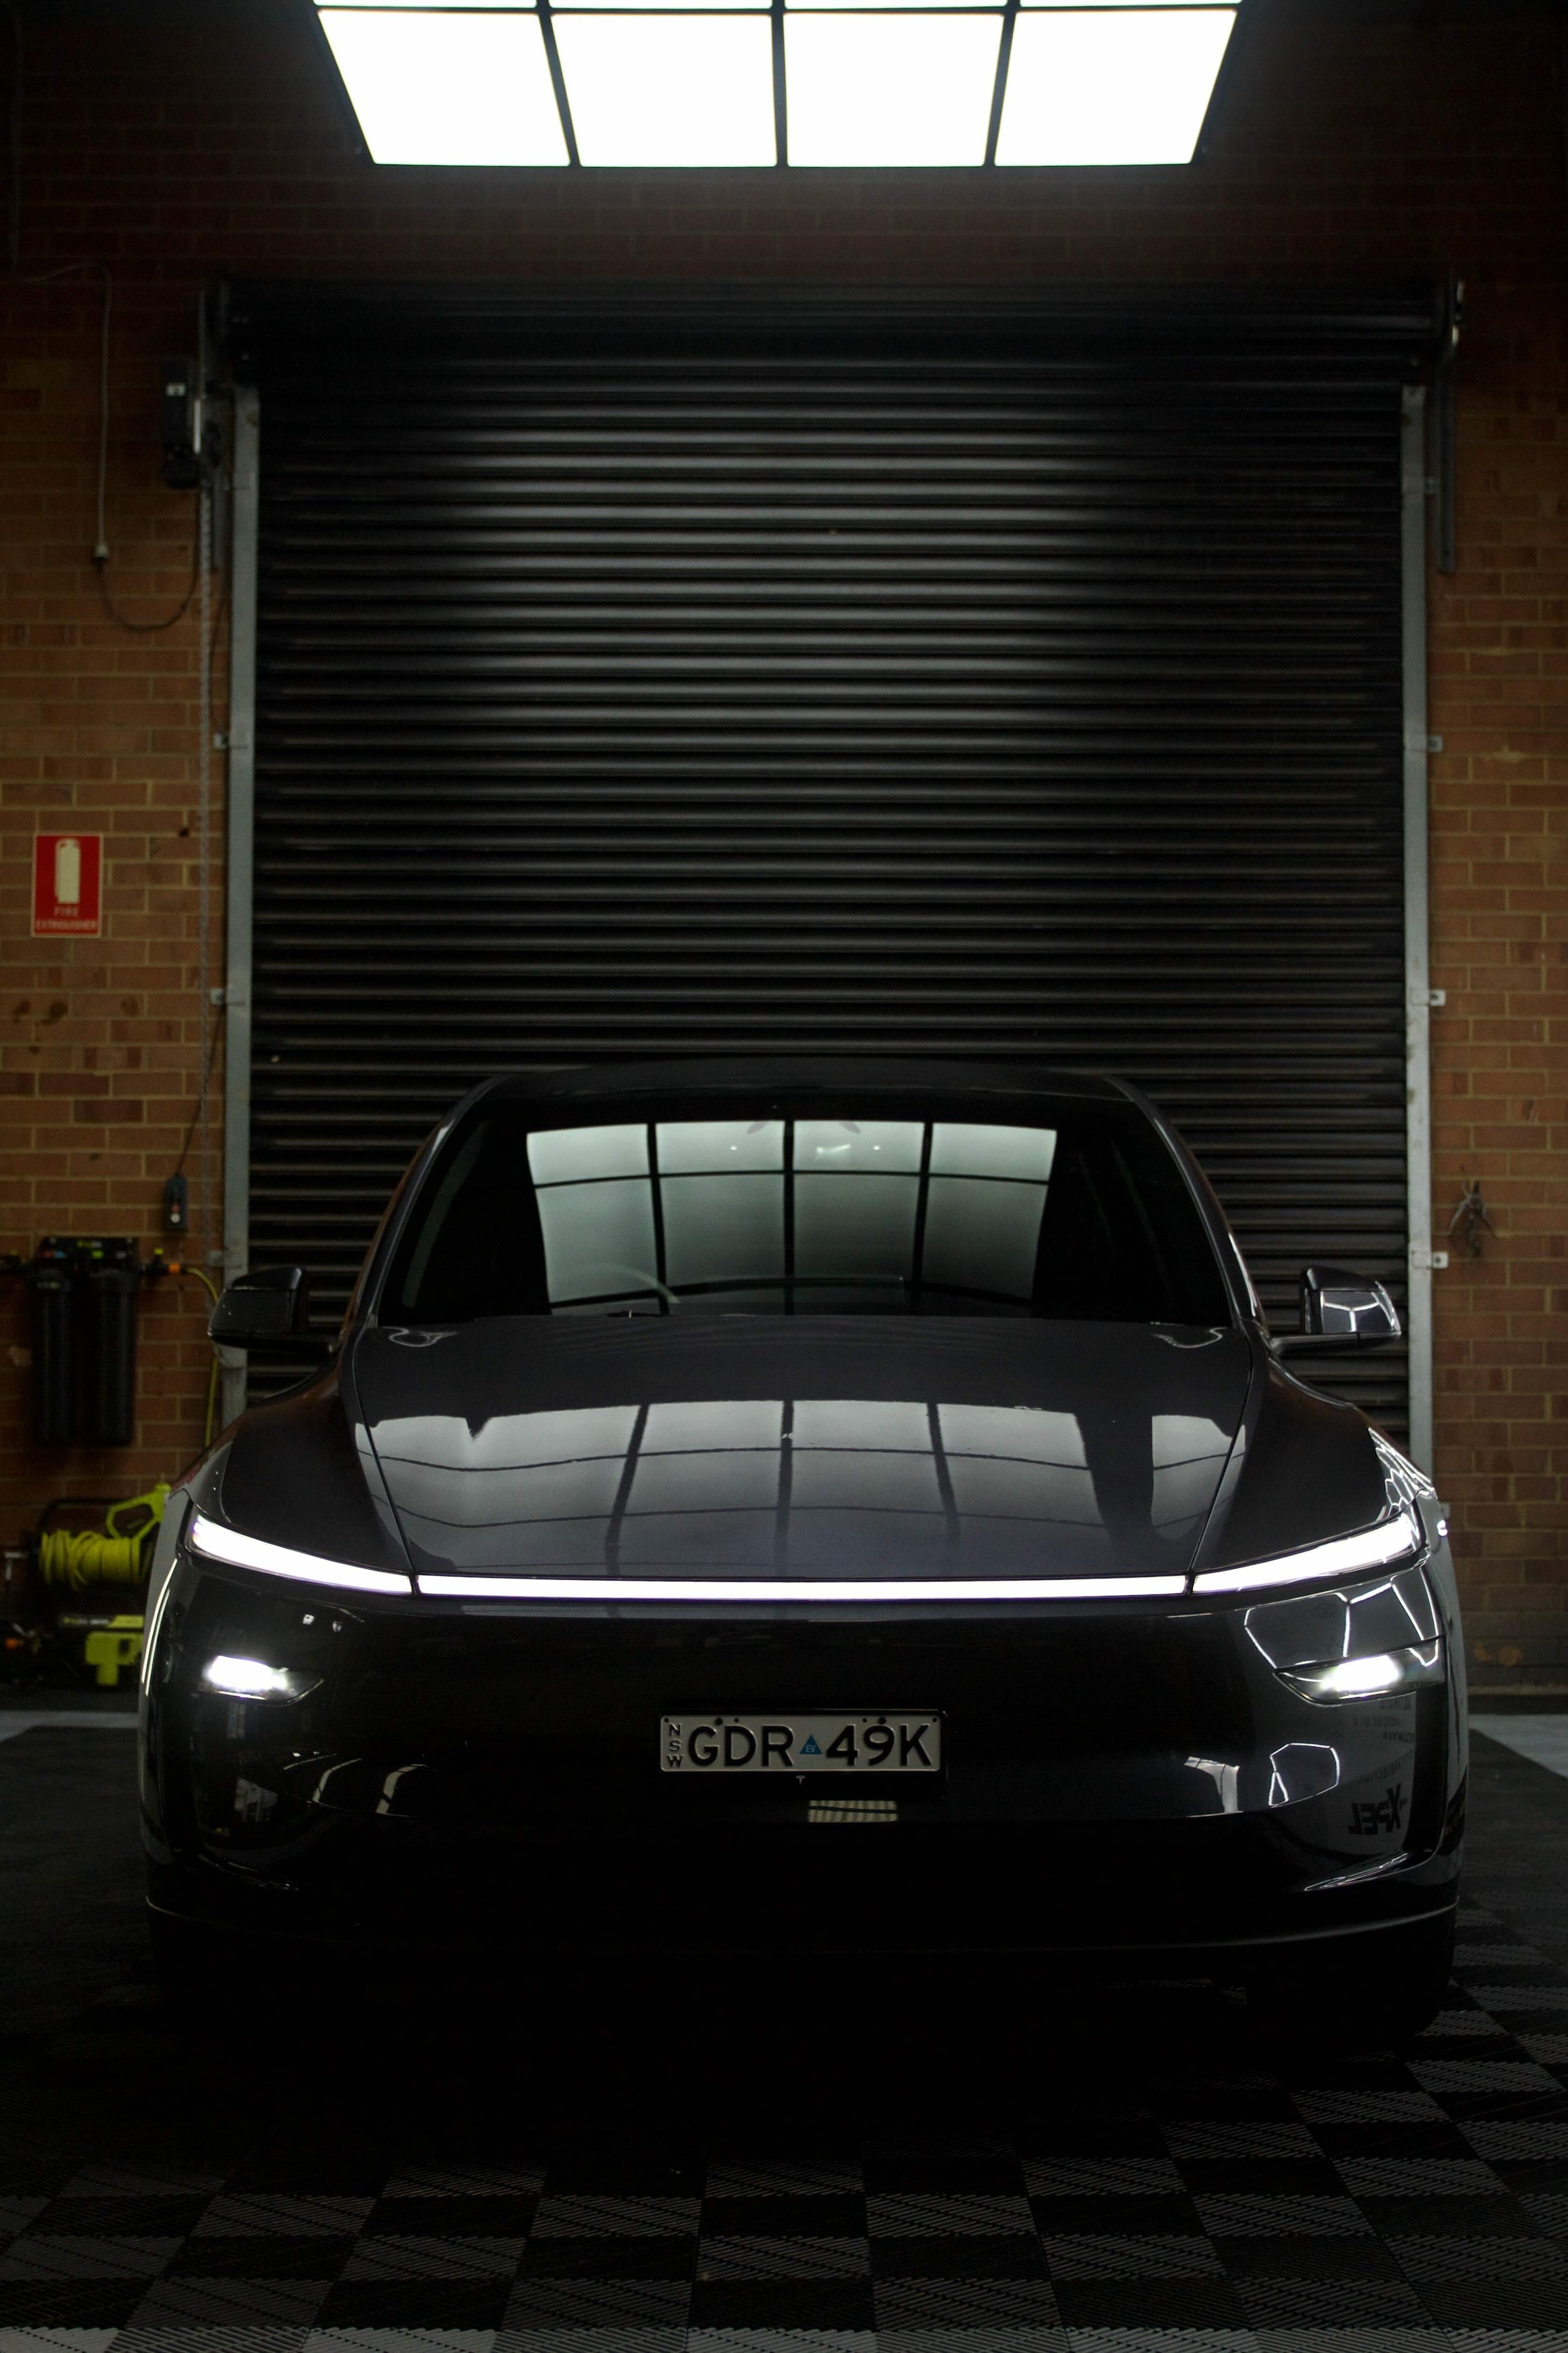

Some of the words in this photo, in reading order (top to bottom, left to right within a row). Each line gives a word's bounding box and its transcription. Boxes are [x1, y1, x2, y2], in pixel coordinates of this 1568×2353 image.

[688, 1724, 794, 1766] GDR
[825, 1724, 933, 1766] 49K
[805, 1745, 816, 1753] EV
